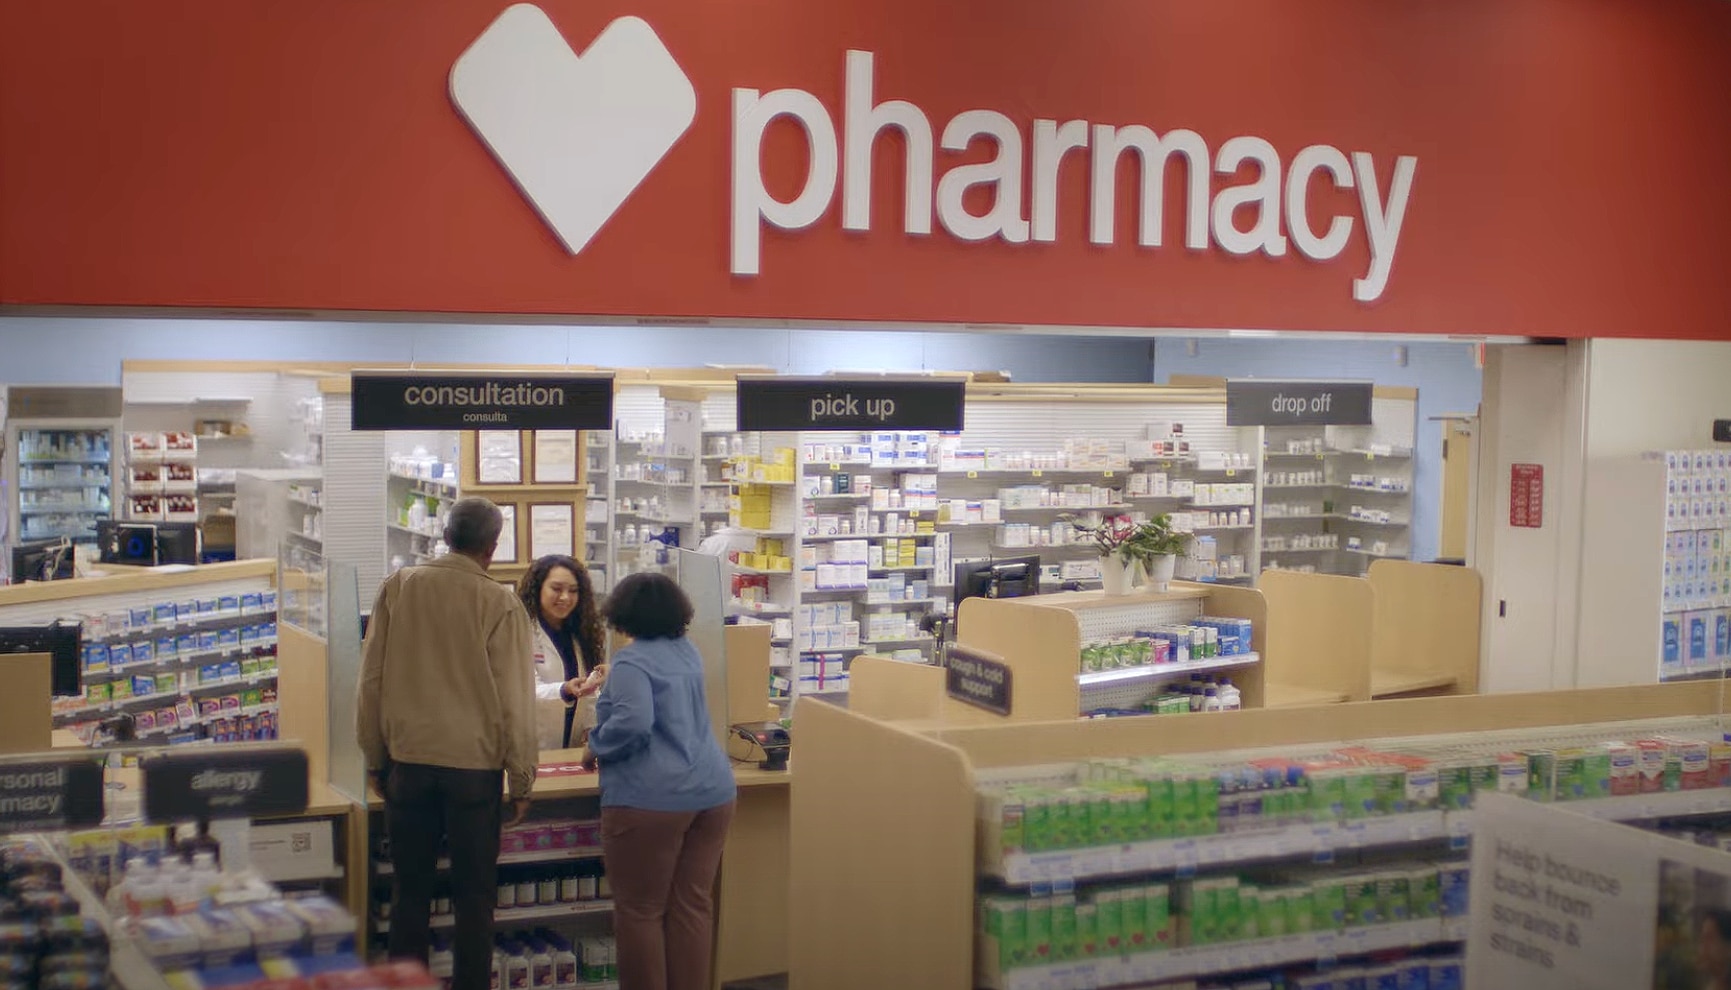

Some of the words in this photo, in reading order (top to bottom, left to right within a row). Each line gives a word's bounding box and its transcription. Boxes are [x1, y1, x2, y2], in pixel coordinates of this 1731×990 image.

[731, 49, 1417, 301] pharmacy
[404, 382, 565, 406] consultation
[1272, 393, 1306, 416] drop
[1311, 393, 1332, 412] off
[463, 411, 507, 423] consulta
[811, 393, 859, 421] pick
[866, 397, 895, 421] up
[191, 770, 262, 791] allergy
